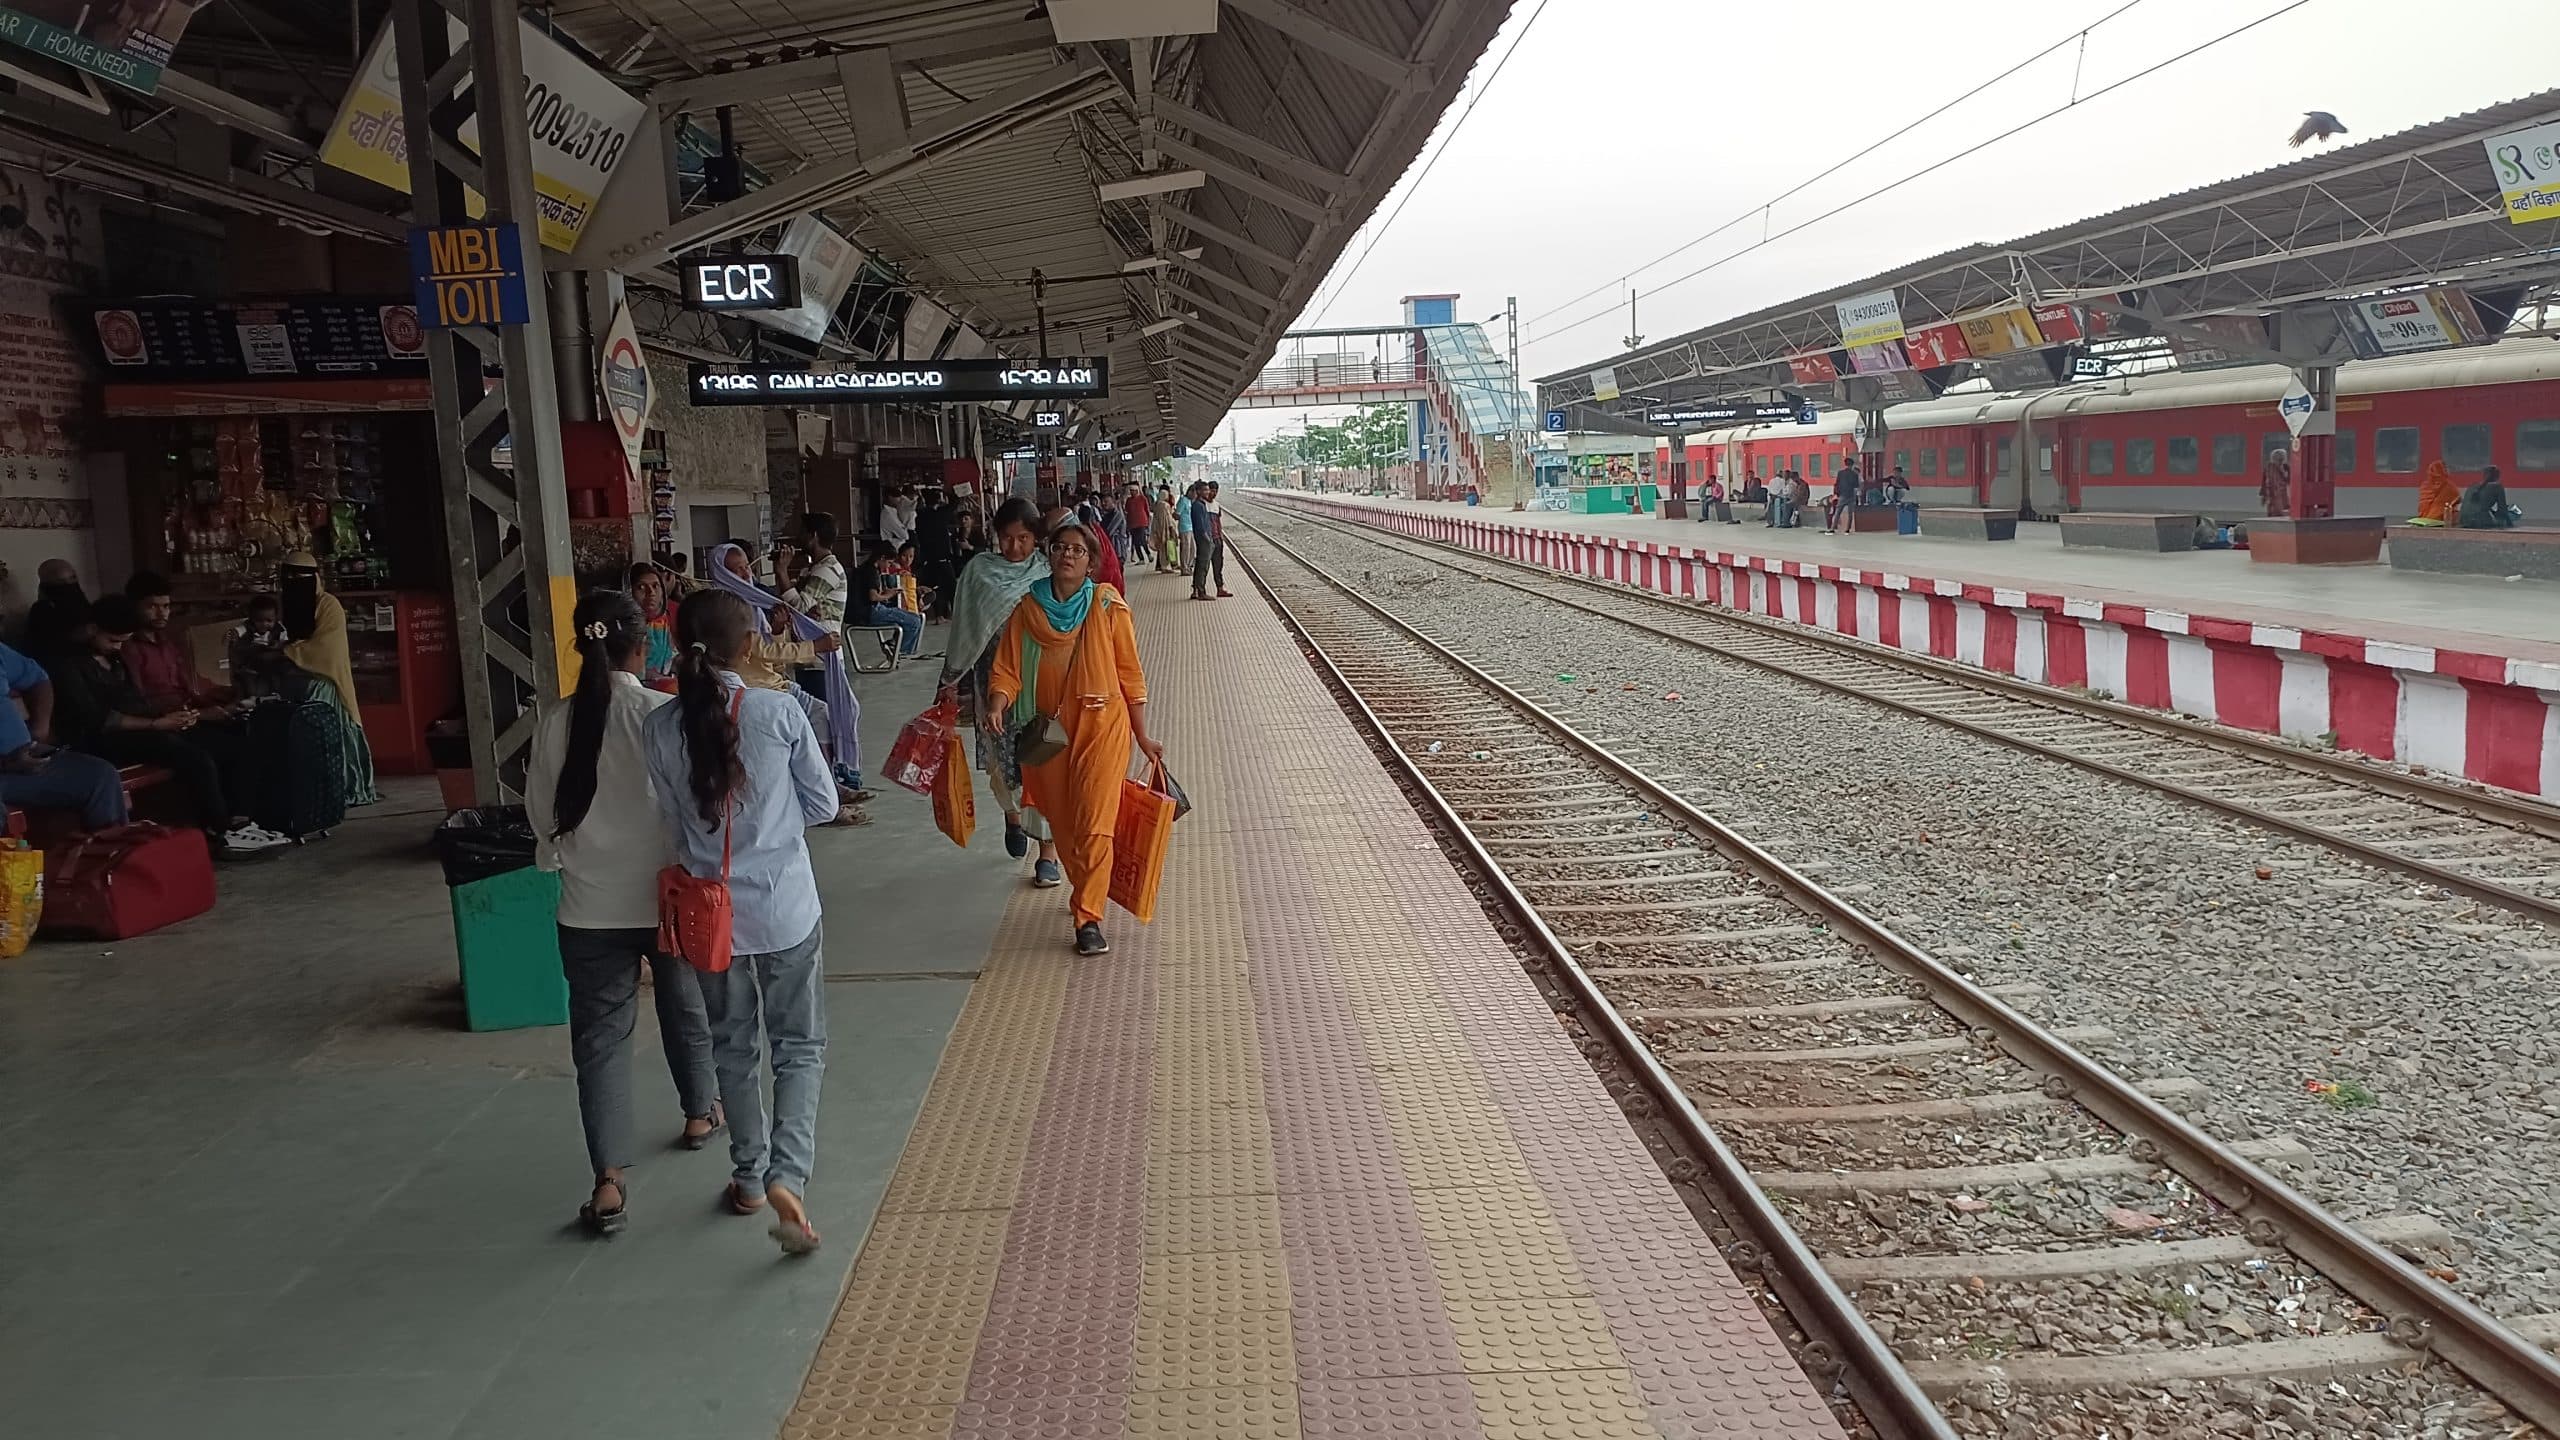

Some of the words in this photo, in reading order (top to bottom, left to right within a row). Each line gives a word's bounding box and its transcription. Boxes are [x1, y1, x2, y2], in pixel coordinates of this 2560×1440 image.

[44, 31, 94, 64] HOME
[92, 51, 138, 80] NEEDS
[523, 74, 626, 174] 0092518
[428, 227, 504, 274] MBI
[699, 264, 775, 301] ECR
[2385, 302, 2413, 314] Citykart
[1968, 319, 1994, 338] EURO
[2076, 357, 2103, 374] ECR
[1036, 412, 1061, 427] ECR
[1552, 415, 1562, 428] 2
[1803, 409, 1812, 420] 3
